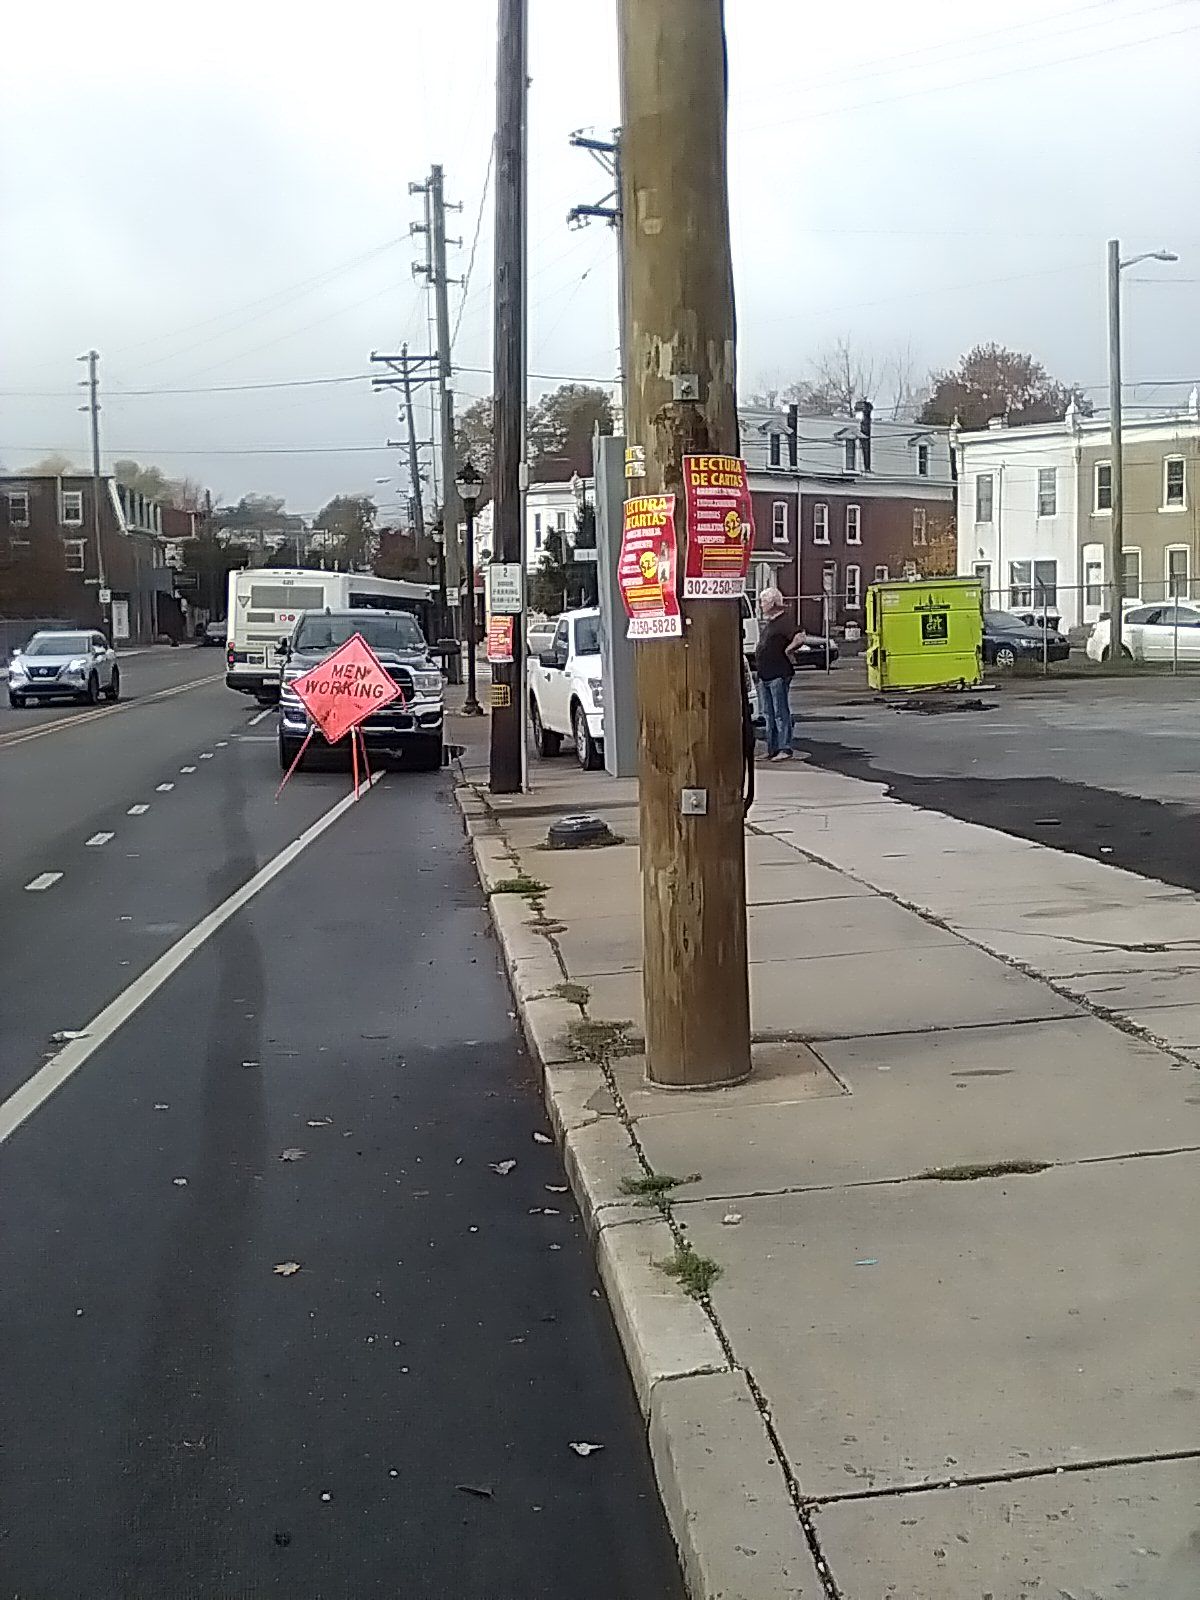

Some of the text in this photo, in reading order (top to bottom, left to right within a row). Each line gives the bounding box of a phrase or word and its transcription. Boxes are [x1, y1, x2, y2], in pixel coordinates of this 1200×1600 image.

[690, 457, 742, 473] LECTURA
[691, 472, 744, 488] DE CARTAS
[503, 567, 508, 578] 2
[331, 664, 367, 680] MEN
[305, 680, 384, 699] WORKING
